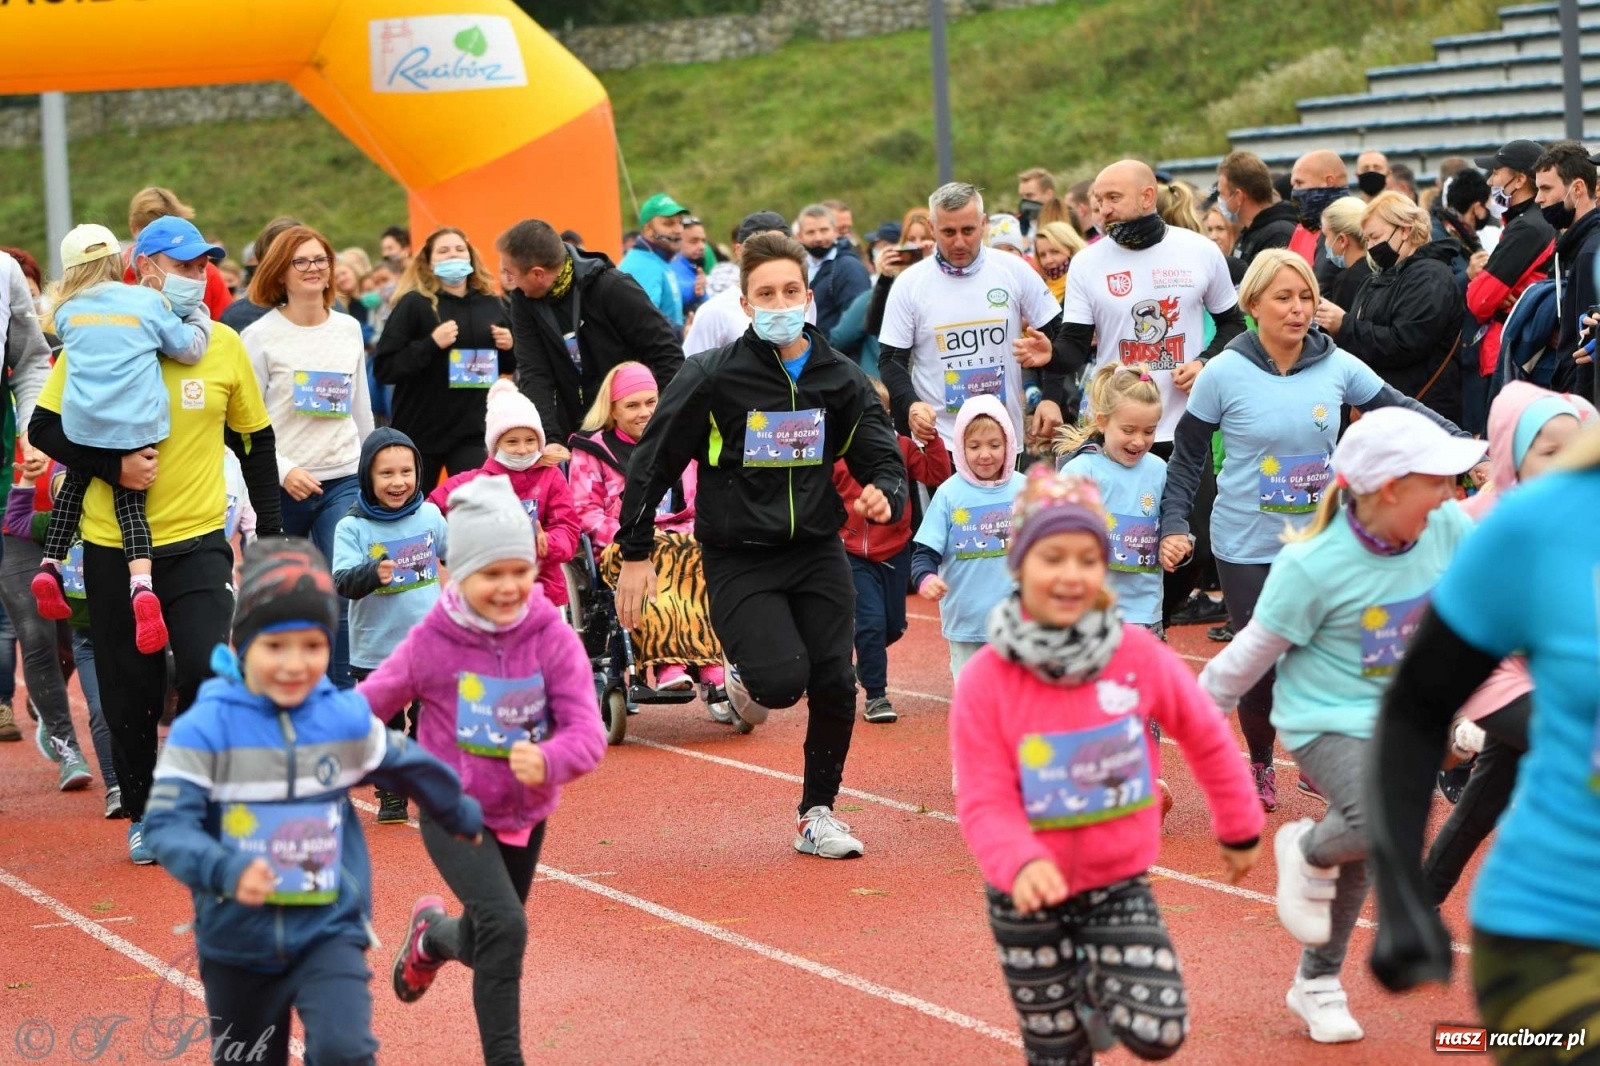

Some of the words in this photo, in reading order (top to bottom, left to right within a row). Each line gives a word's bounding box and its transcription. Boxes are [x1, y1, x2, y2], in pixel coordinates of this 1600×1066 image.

[330, 402, 346, 412] 321
[792, 448, 816, 458] 015
[414, 568, 432, 580] 148
